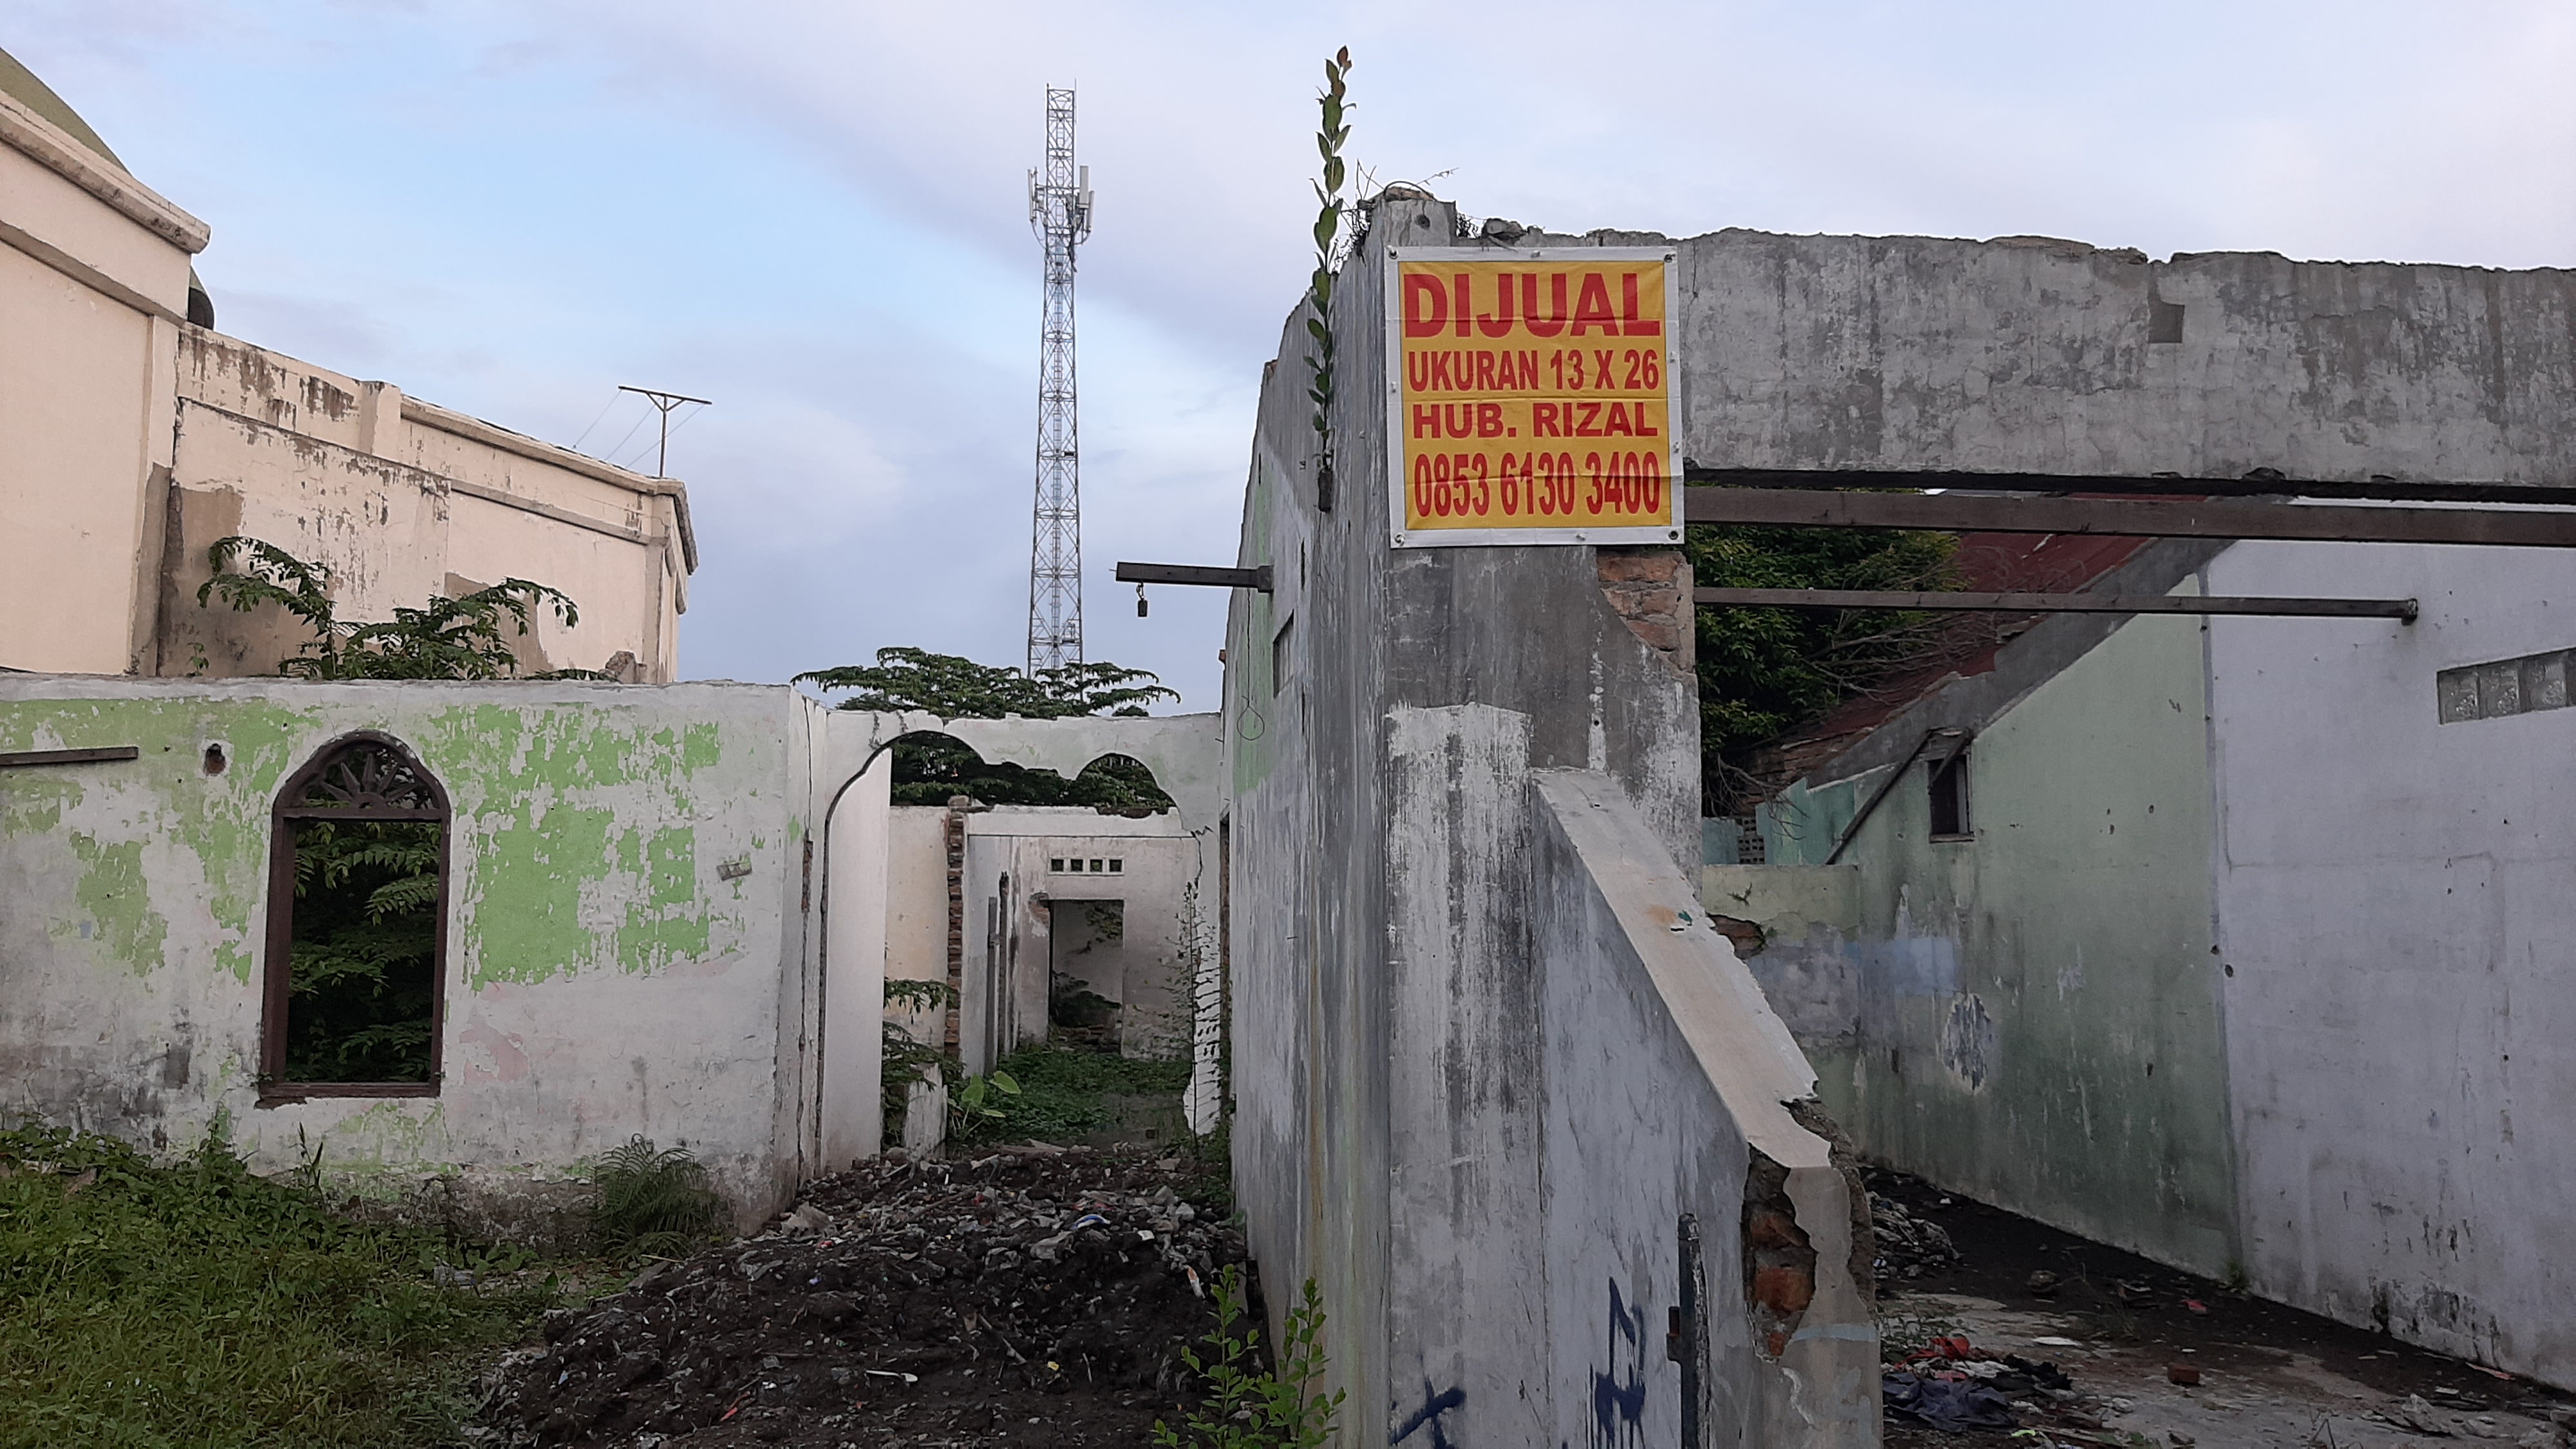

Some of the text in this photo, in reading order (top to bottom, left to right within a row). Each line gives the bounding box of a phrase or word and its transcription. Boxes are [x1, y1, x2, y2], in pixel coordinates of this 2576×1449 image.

[1404, 273, 1662, 338] DIJUAL
[1409, 349, 1660, 392] UKURAN 13 X 26
[1413, 402, 1659, 439] HUB. RIZAL
[1415, 451, 1661, 517] 0853 6130 3400
